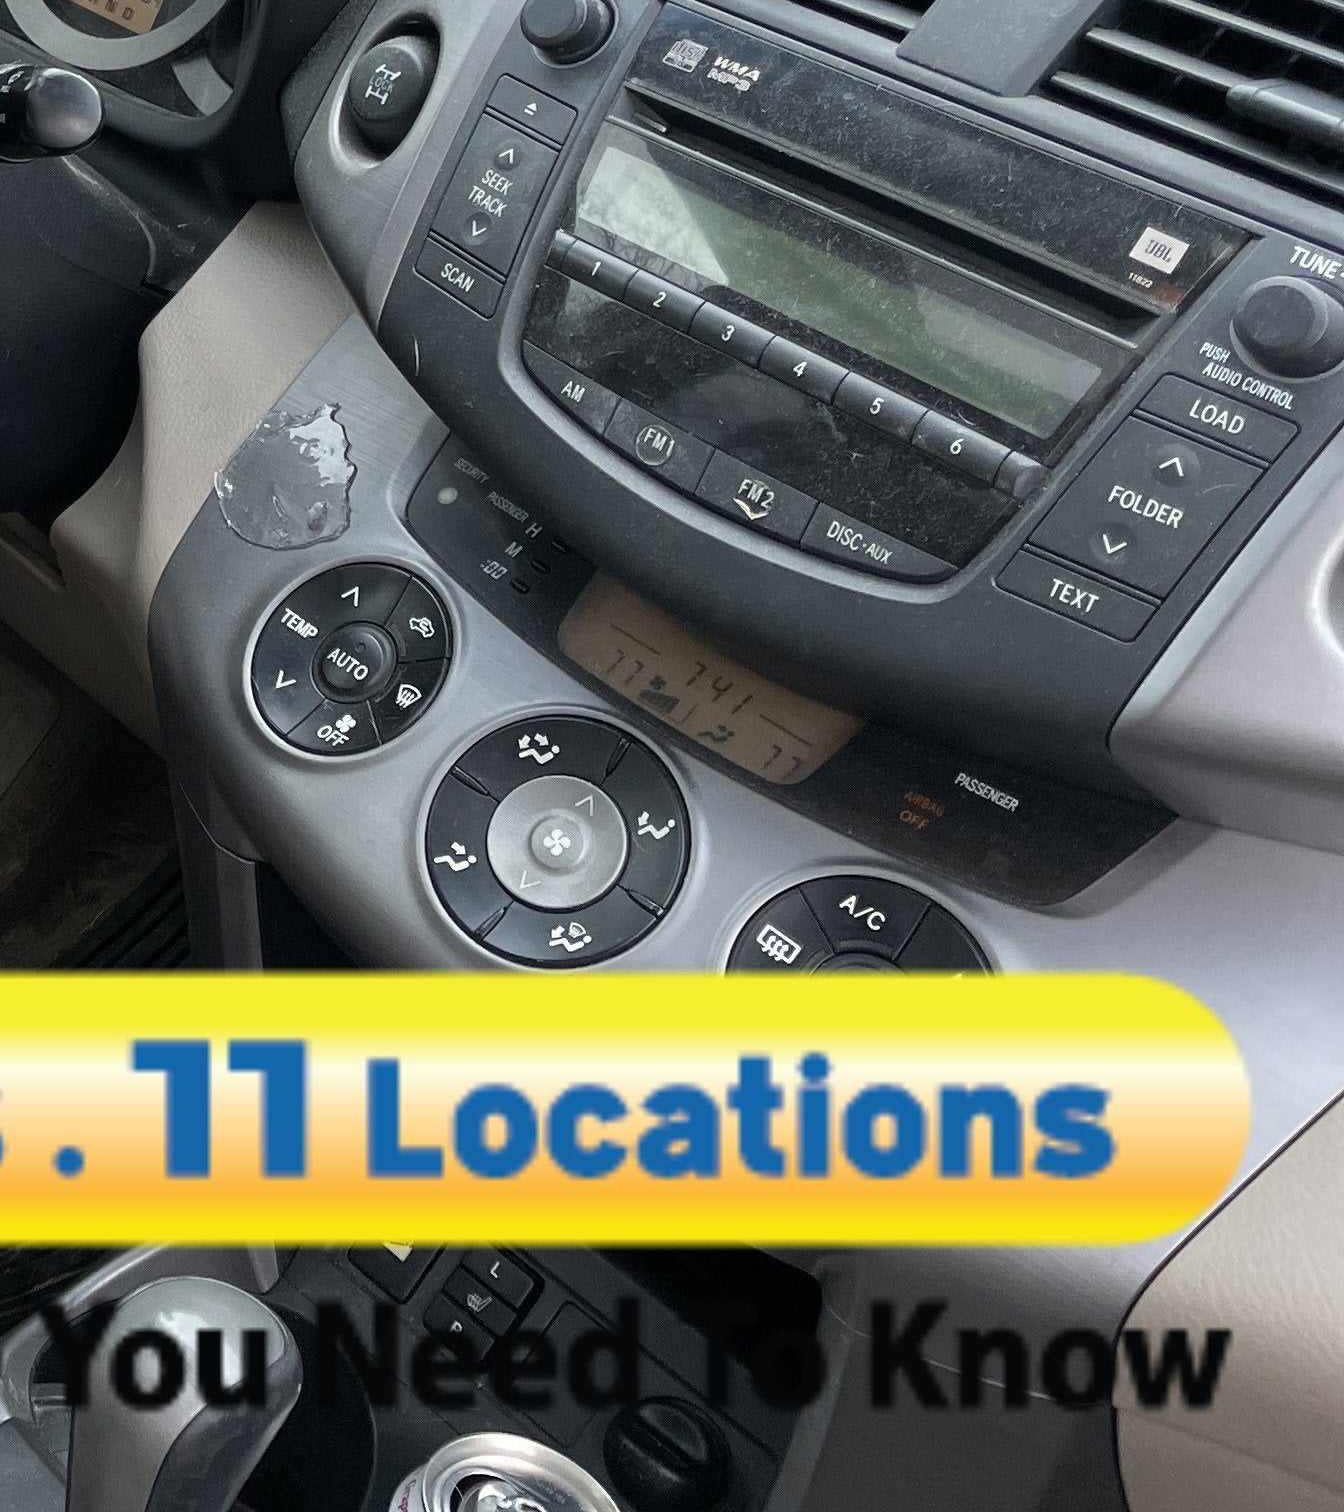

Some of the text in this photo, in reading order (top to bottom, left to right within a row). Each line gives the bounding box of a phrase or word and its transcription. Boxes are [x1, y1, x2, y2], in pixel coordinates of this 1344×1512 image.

[707, 68, 751, 91] MP3
[713, 56, 760, 82] WMA
[481, 169, 514, 196] SEEK
[467, 185, 508, 218] TRACK
[1144, 238, 1172, 263] JBL
[440, 262, 475, 292] SCAN
[590, 261, 602, 277] 1
[653, 291, 665, 308] 2
[721, 324, 735, 342] 3
[1199, 342, 1231, 363] PUSH
[792, 360, 807, 377] 4
[561, 380, 586, 403] AM
[1202, 361, 1295, 410] AUDIO CONTROL
[870, 397, 882, 414] 5
[1189, 399, 1246, 435] LOAD
[642, 426, 674, 458] FM1
[949, 437, 963, 455] 6
[454, 457, 490, 484] SECURITY
[487, 491, 530, 523] PASSENGER
[737, 478, 775, 510] FM2
[1107, 484, 1184, 529] FOLDER
[525, 522, 543, 538] H
[504, 541, 523, 558] M
[1049, 577, 1099, 614] TEXT
[280, 607, 319, 638] TEMP
[326, 647, 369, 681] AUTO
[606, 648, 643, 686] 77
[316, 725, 350, 747] OFF
[762, 743, 802, 782] 77
[954, 772, 1019, 812] PASSENGER
[899, 809, 930, 829] OFF
[838, 894, 886, 931] A/C
[490, 1261, 500, 1278] L
